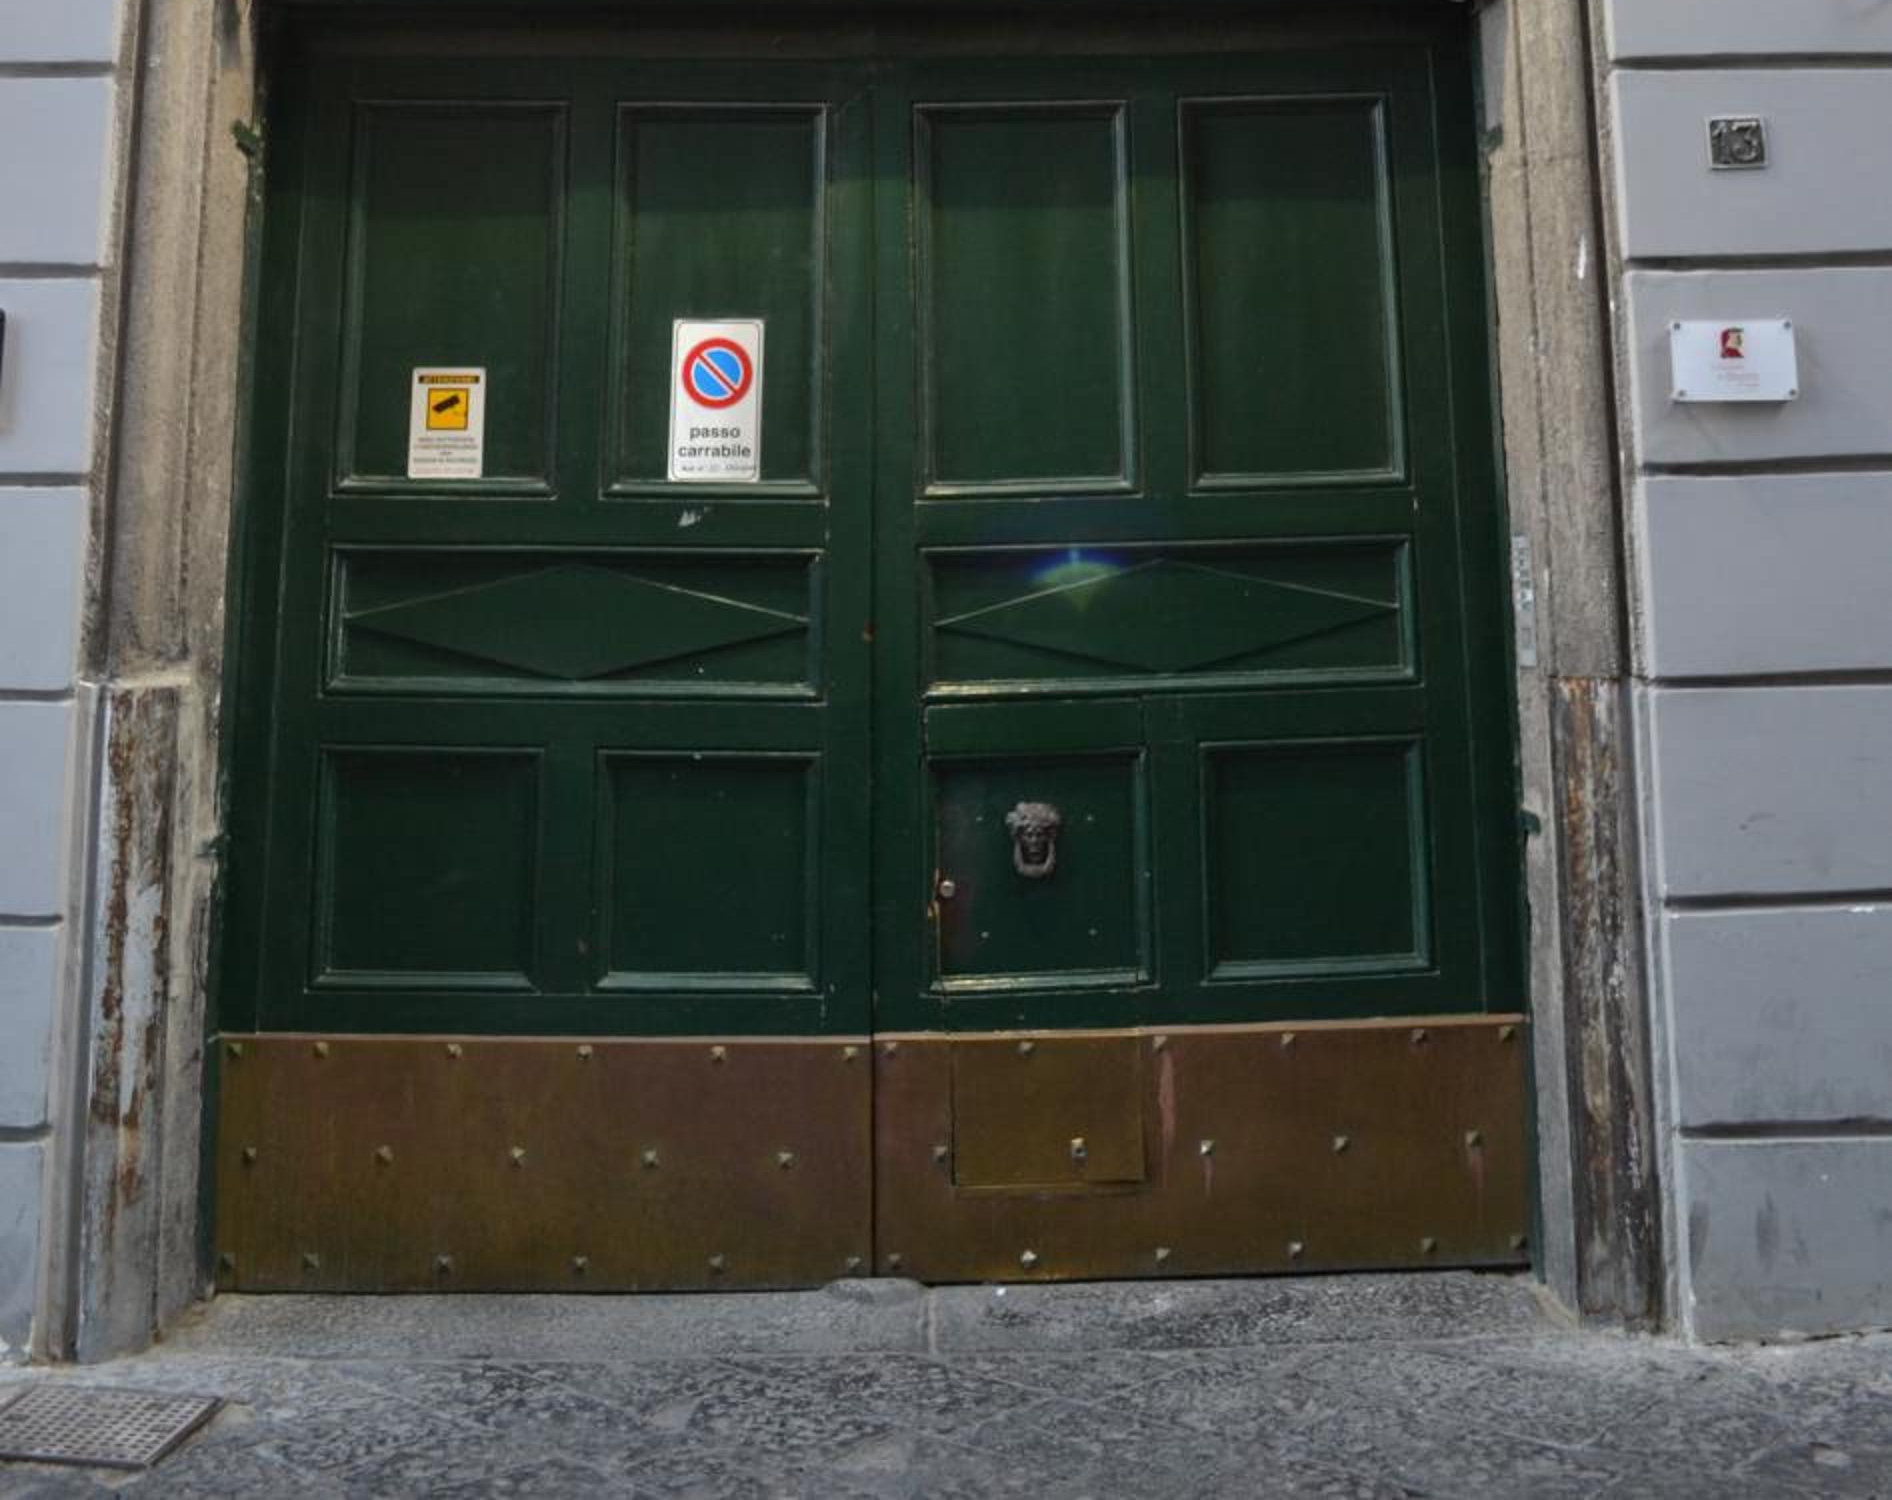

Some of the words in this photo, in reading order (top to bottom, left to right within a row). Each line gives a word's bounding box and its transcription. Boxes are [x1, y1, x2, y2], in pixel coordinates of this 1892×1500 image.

[1711, 121, 1758, 161] 13
[689, 427, 741, 441] passo
[677, 444, 752, 458] carrabile
